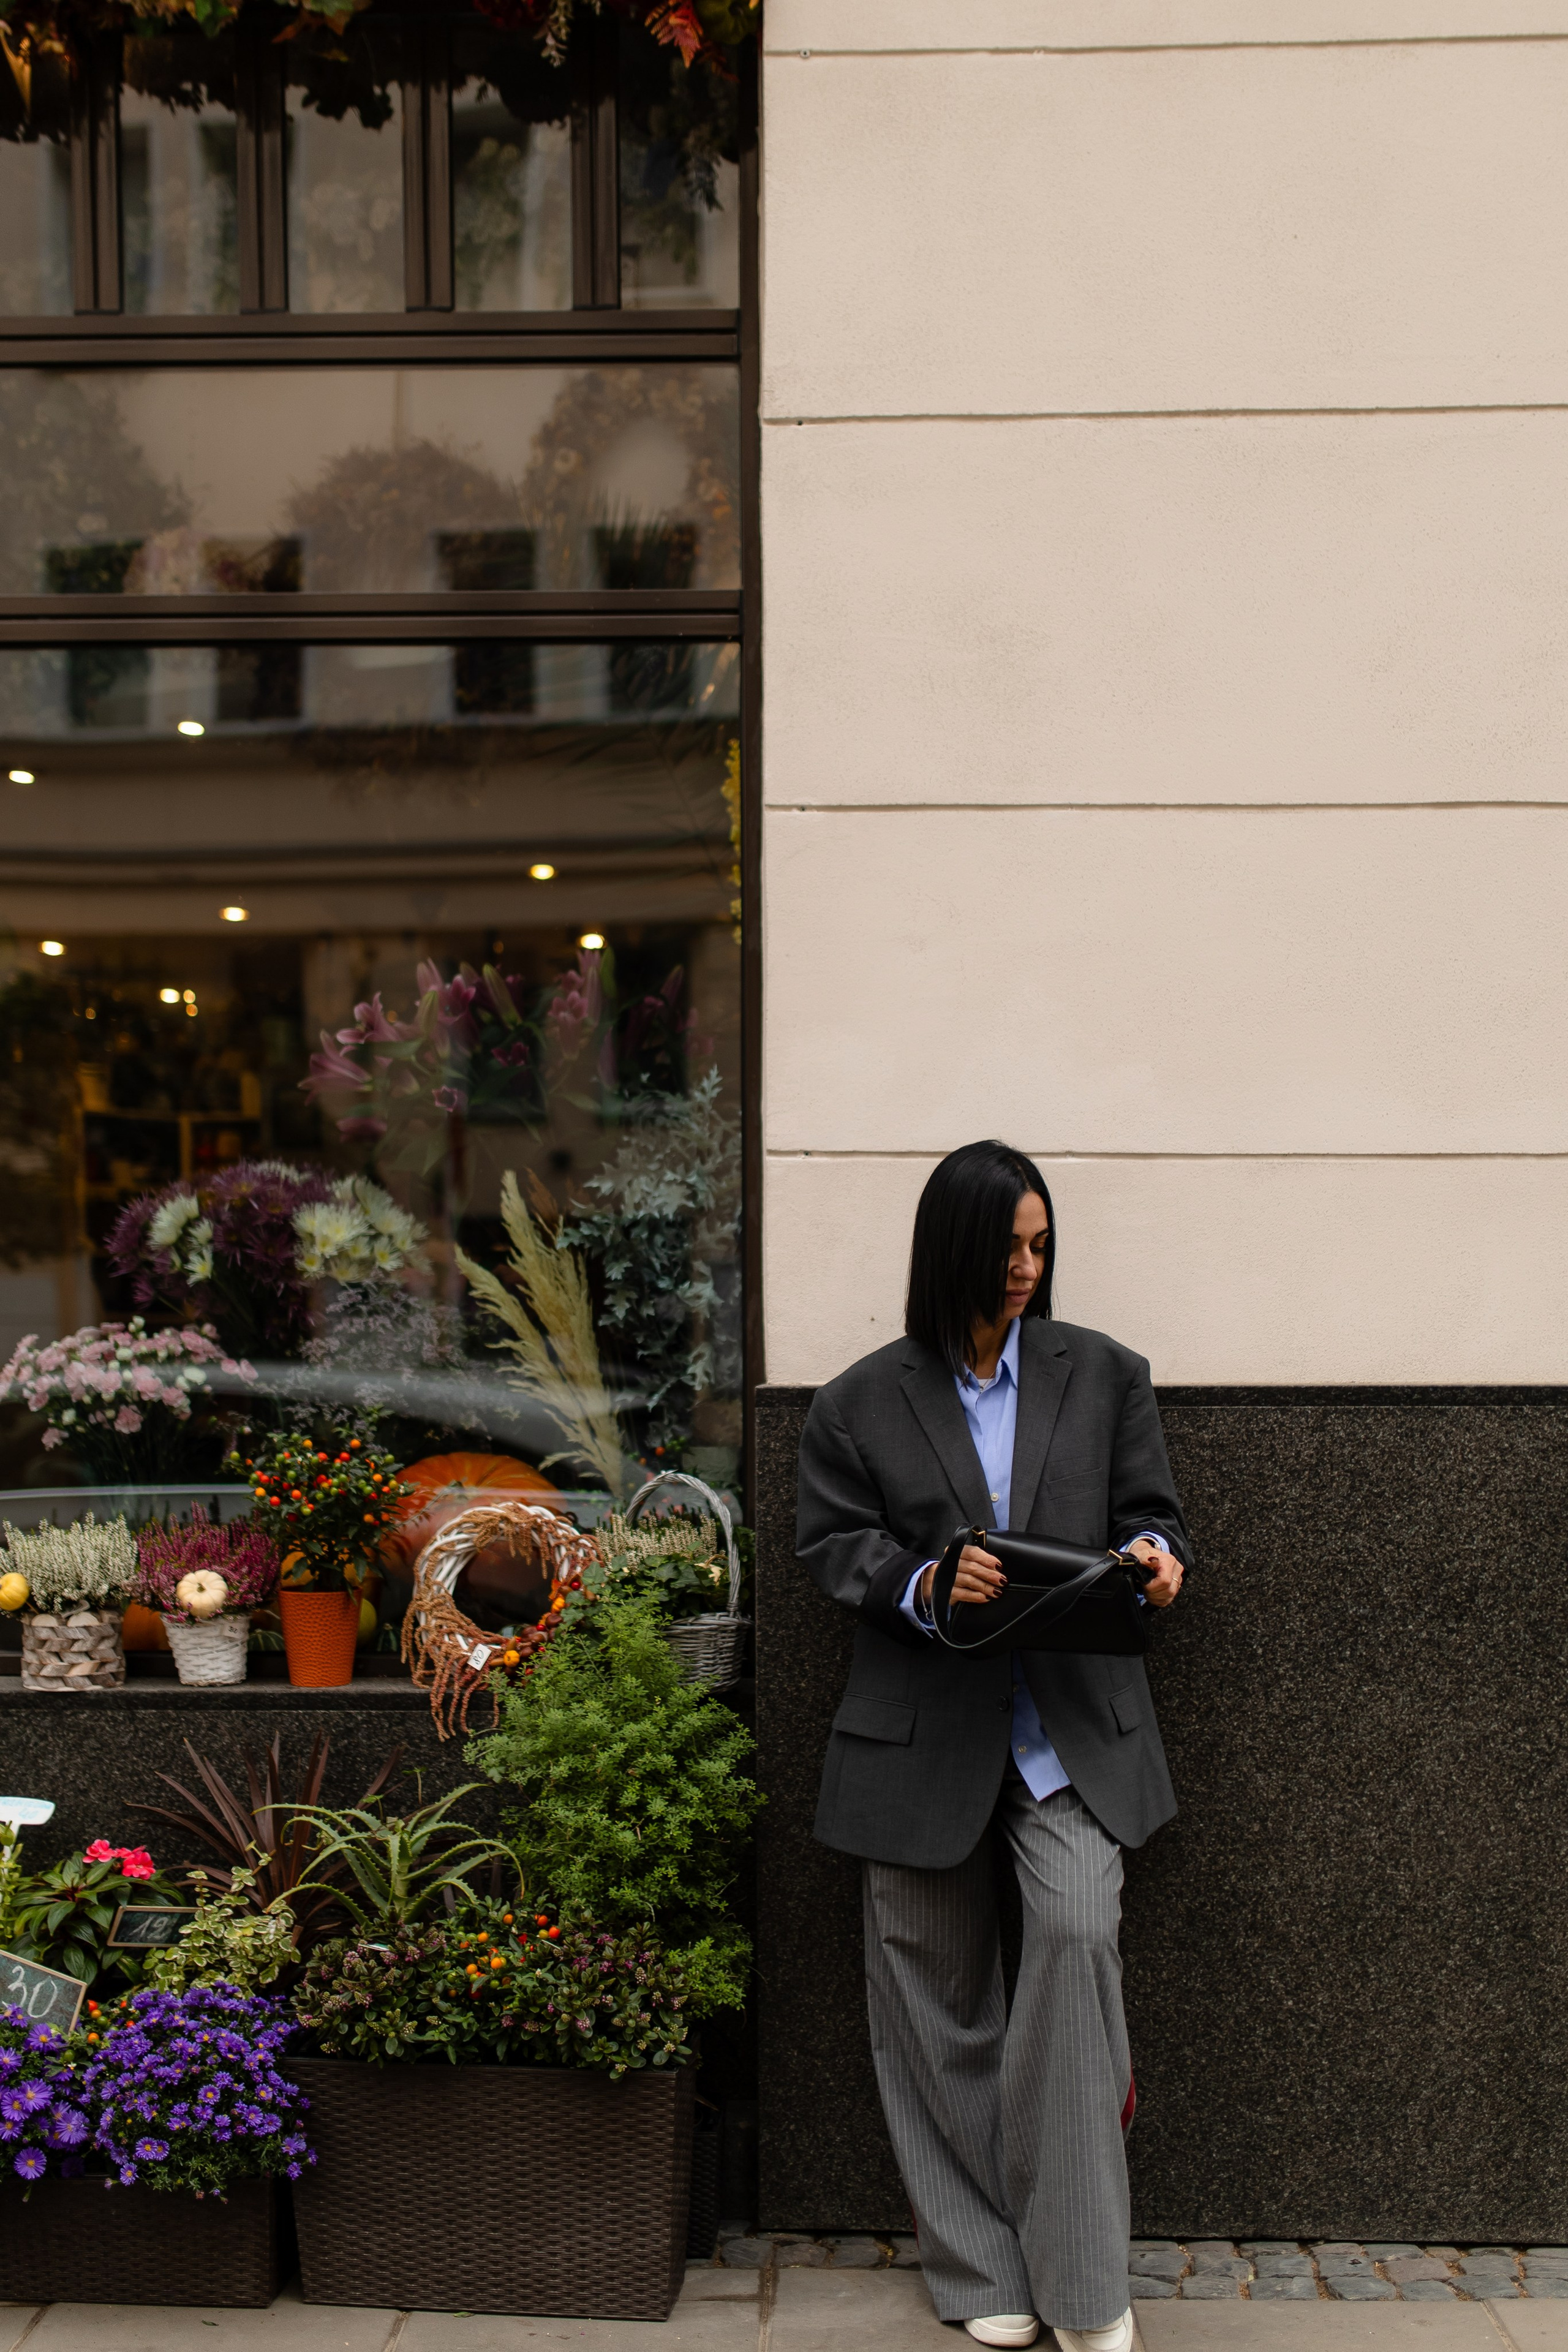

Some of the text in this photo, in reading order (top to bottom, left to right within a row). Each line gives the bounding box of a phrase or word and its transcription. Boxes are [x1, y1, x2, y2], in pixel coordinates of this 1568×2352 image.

[473, 1649, 484, 1665] 80
[129, 1916, 168, 1940] 19
[2, 1965, 58, 2018] 30
